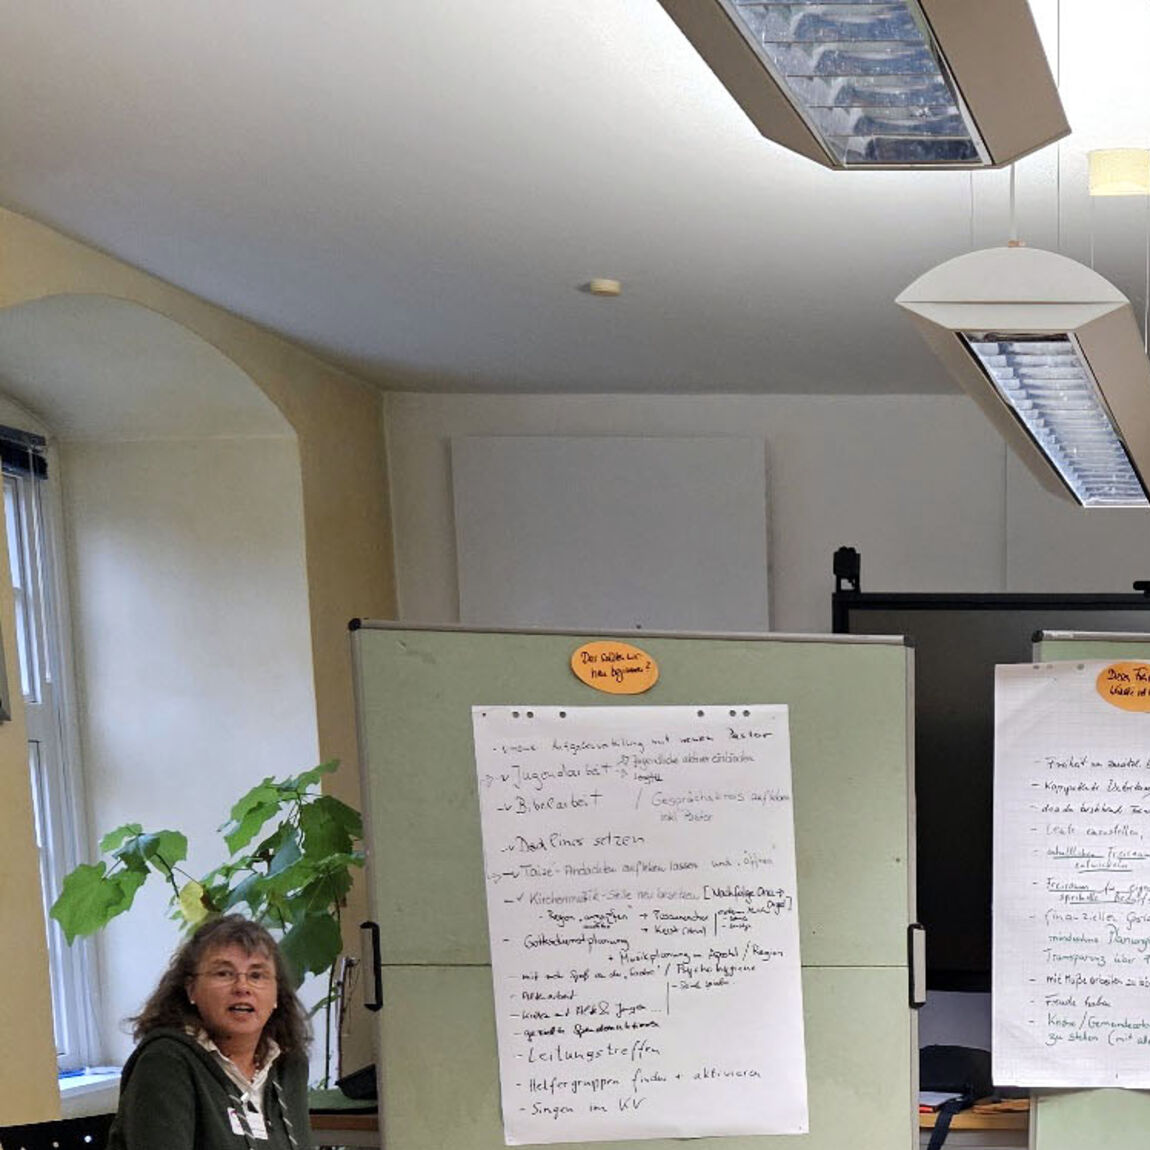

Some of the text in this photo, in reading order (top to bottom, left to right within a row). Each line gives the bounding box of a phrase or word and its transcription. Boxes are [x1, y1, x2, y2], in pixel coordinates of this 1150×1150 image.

[580, 651, 597, 664] Das
[593, 832, 646, 848] setzen
[1046, 972, 1062, 985] mit
[528, 1039, 661, 1064] Leitungstreffen
[530, 1077, 621, 1095] Helfergruppen
[532, 1101, 575, 1121] Singen
